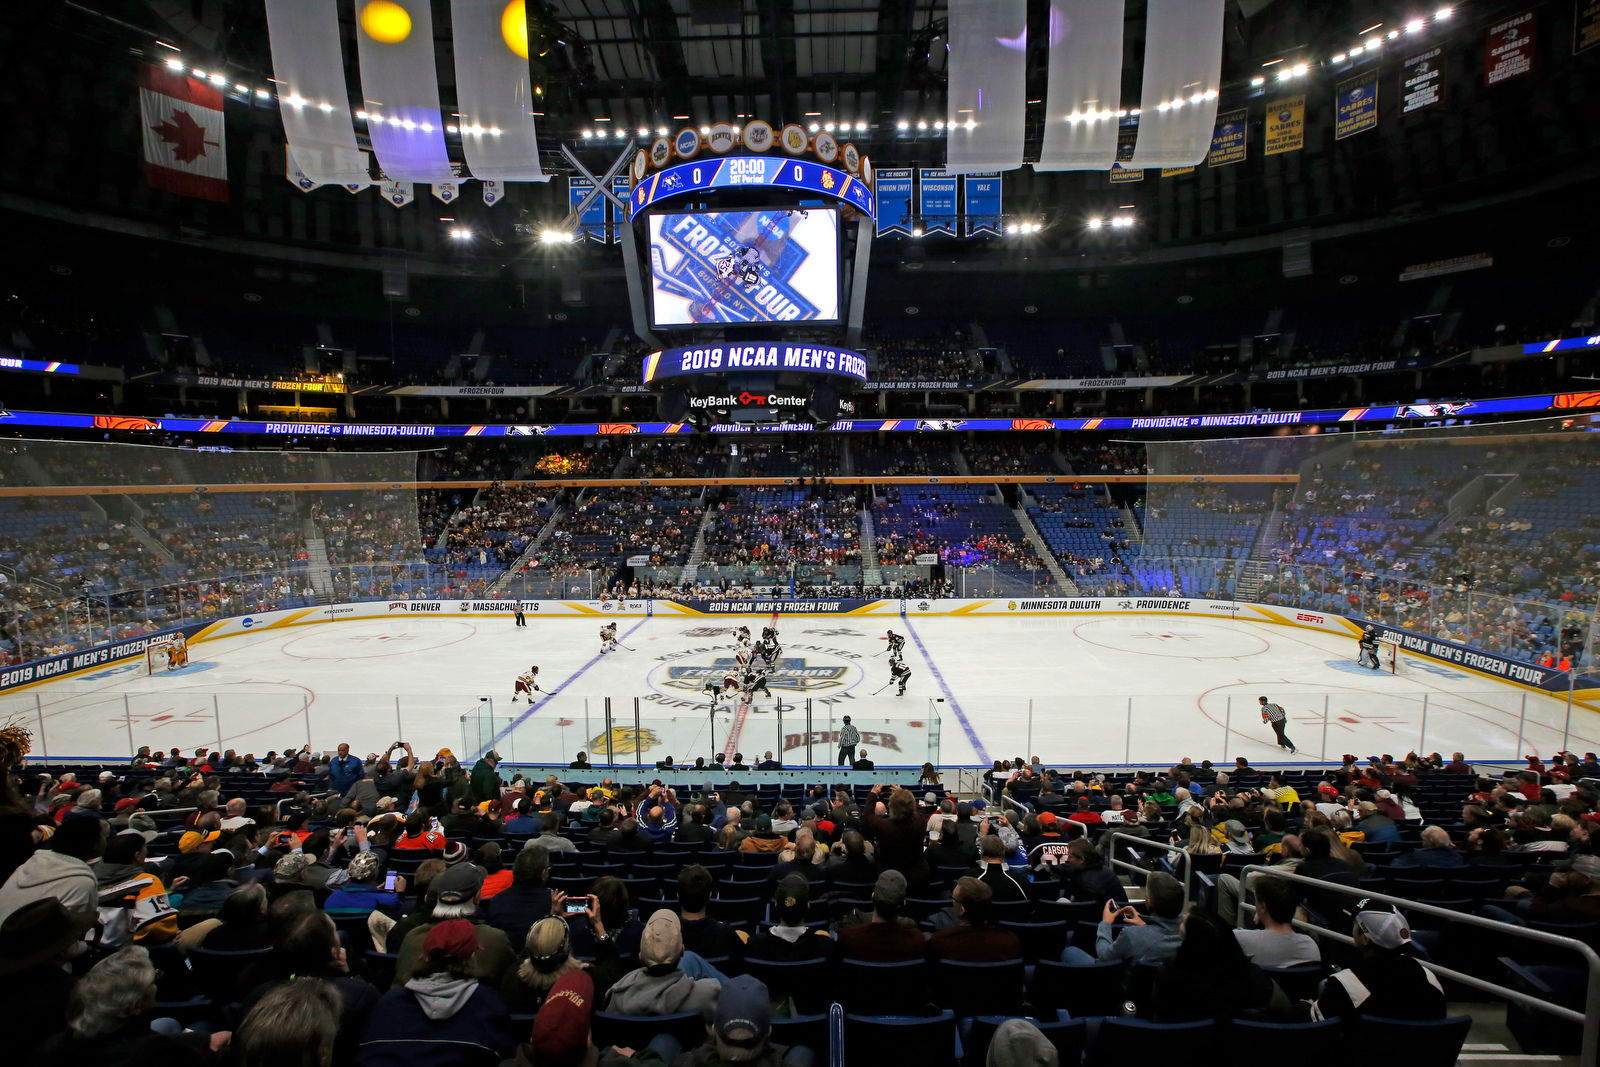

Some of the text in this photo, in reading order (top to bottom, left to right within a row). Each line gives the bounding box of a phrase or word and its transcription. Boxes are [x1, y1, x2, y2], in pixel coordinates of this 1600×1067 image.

[1490, 13, 1532, 35] BUFFALO
[1491, 36, 1530, 56] SABRES
[1405, 69, 1439, 87] SABRES
[1268, 101, 1304, 113] BUFFALO
[1340, 96, 1373, 114] SABRES
[1269, 120, 1301, 132] SABRES
[1338, 119, 1375, 134] CHAMPIONS
[711, 132, 732, 143] DENVER
[1213, 132, 1243, 144] SABRES
[1266, 141, 1302, 151] CHAMPIONS
[1210, 152, 1244, 163] CHAMPIONS
[730, 159, 765, 174] 20:00
[693, 168, 701, 184] 0
[794, 165, 803, 181] 0
[1112, 172, 1142, 180] CHAMPIONS
[730, 175, 764, 184] 1ST Period
[879, 184, 896, 192] UNION
[922, 184, 954, 192] WISCONSIN
[758, 215, 785, 239] NCAA
[733, 300, 746, 311] NY
[681, 349, 722, 371] 2019
[728, 347, 778, 367] NCAA
[784, 348, 836, 370] MEN'S
[1266, 360, 1397, 379] 2019 NCAA MEN'S FROZEN FOUR
[198, 376, 323, 391] 2019 NCAA MEN'S FROZEN FOUR
[917, 381, 941, 389] FROZEN
[1079, 378, 1127, 387] #FROZENFOUR
[458, 387, 505, 395] #FROZENFOUR
[690, 394, 807, 409] KeyBank Center
[1131, 417, 1189, 429] PROVIDENCE
[1201, 412, 1301, 427] MINNESOTA-DULUTH
[265, 422, 330, 434] PROVIDENCE
[343, 424, 435, 436] MINNESOTA-DULUTH
[324, 607, 354, 615] #FROZENFOUR
[388, 602, 441, 612] DENVER DENVER
[472, 602, 540, 612] MASSACHUETTS
[709, 602, 840, 611] 2019 NCAA MEN'S FROZEN FOUR
[1020, 600, 1101, 610] MINNESOTA DULUTH
[1136, 600, 1191, 610] PROVIDENCE
[1209, 604, 1240, 612] #FROZENFOUR
[1296, 613, 1324, 624] ESPN
[0, 667, 33, 687] 2019
[36, 658, 69, 678] NCAA
[73, 648, 108, 668] MEN'S
[110, 639, 149, 659] FROZEN
[1382, 629, 1403, 645] 2019
[1404, 635, 1429, 652] NCAA
[1430, 643, 1462, 662] MEN'S
[1464, 652, 1507, 675] FROZEN
[1508, 662, 1543, 685] FOUR
[818, 692, 856, 705] NY
